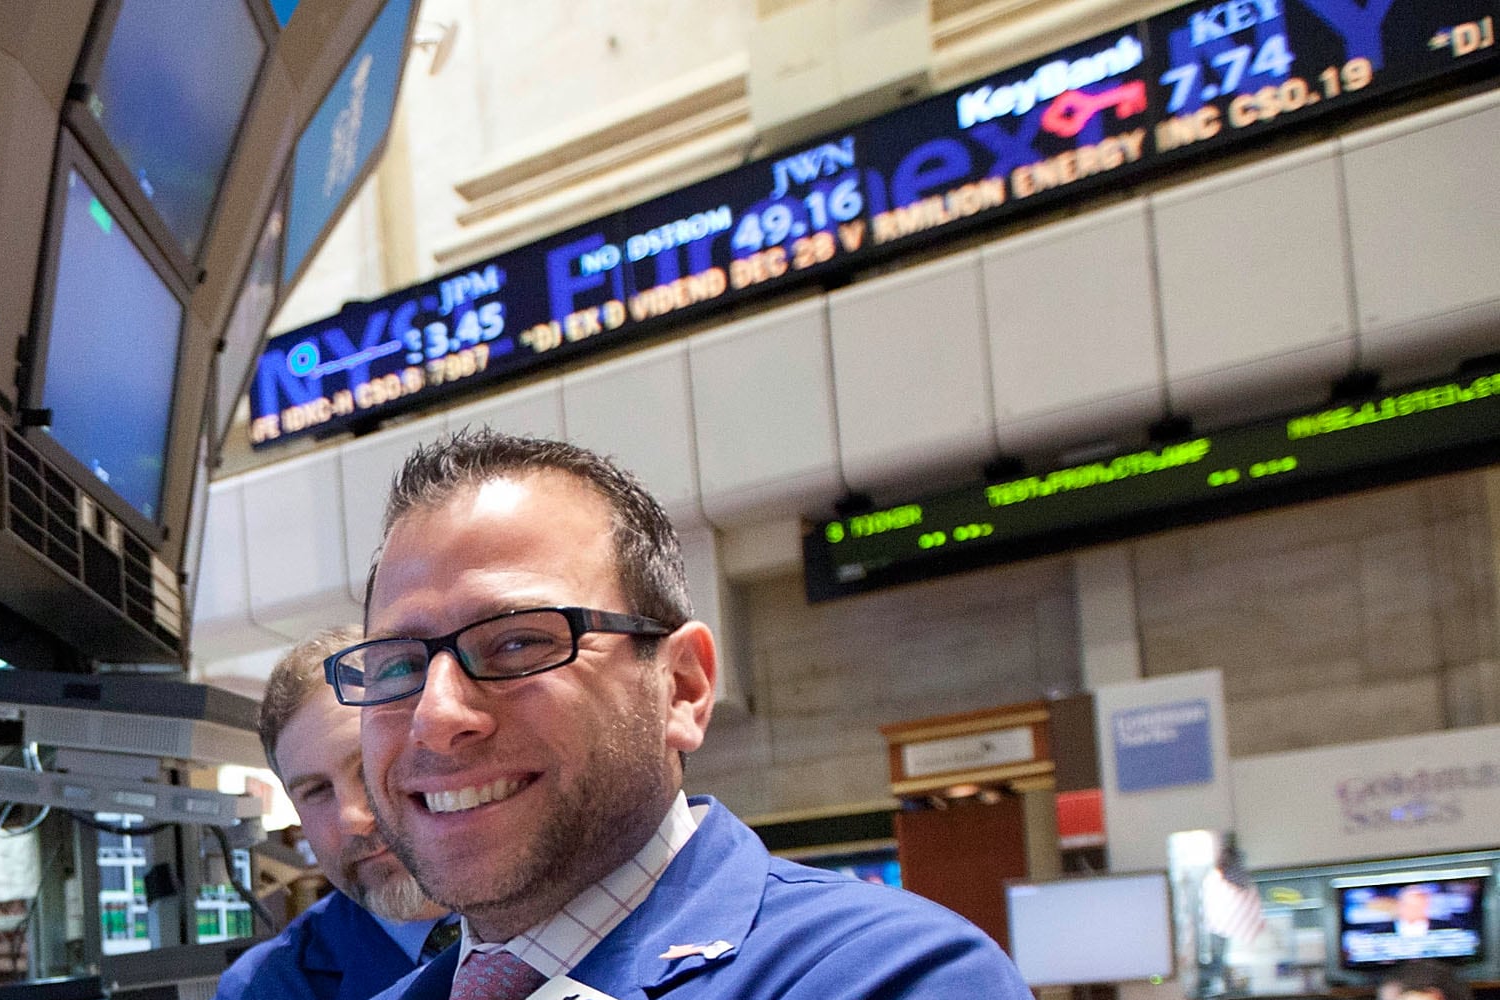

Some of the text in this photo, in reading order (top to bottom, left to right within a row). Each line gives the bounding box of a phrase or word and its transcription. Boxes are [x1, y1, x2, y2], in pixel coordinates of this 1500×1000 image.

[1189, 0, 1284, 46] KEY
[957, 34, 1143, 129] KeyBank
[1159, 33, 1295, 113] 7.74
[1154, 104, 1223, 152] INC
[770, 134, 856, 199] JWN
[731, 178, 863, 250] 49.16
[438, 263, 500, 316] JPM
